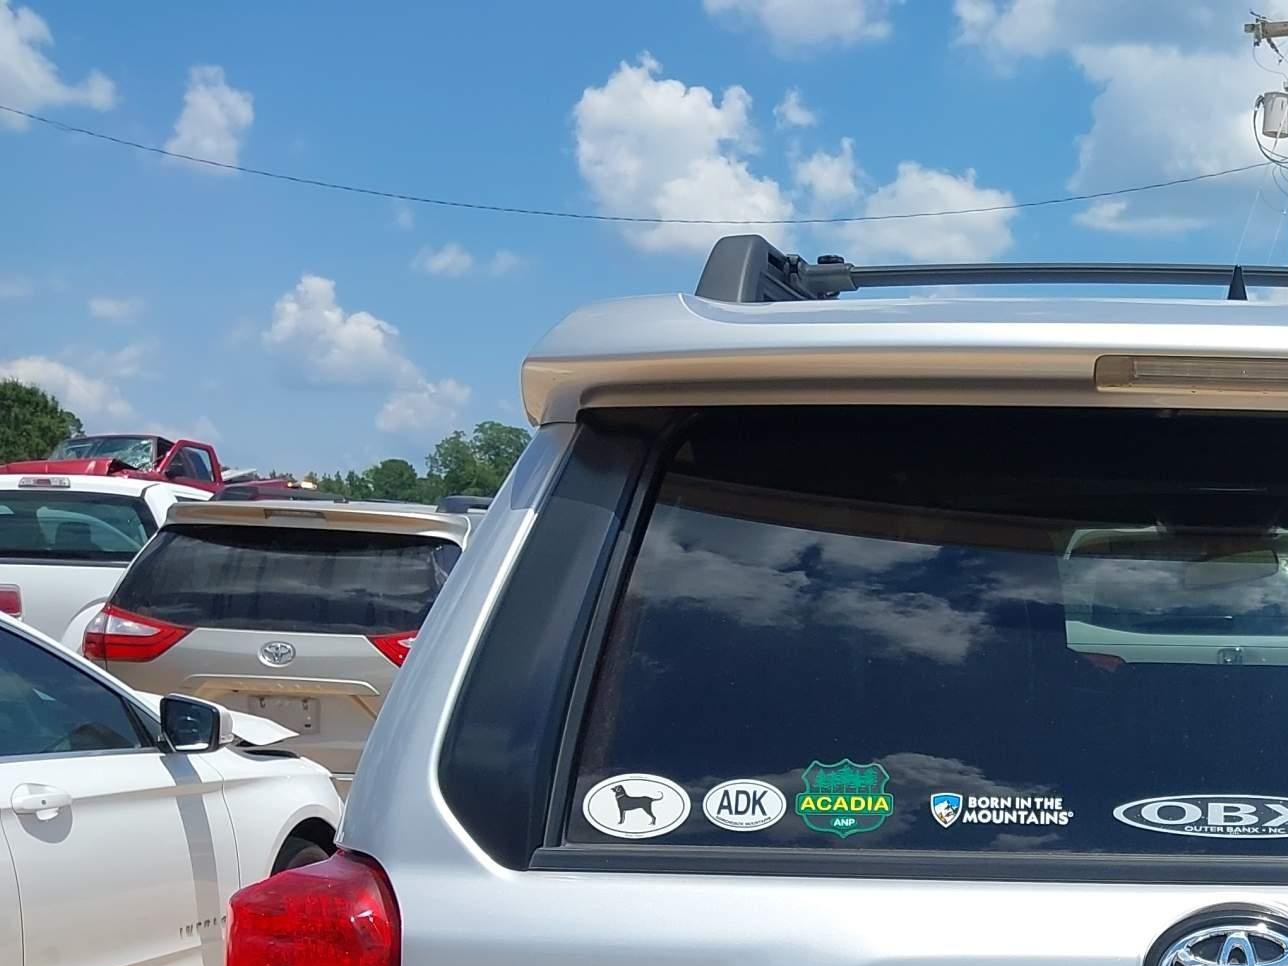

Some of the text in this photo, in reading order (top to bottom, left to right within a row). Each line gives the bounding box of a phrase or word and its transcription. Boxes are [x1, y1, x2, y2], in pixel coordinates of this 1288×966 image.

[716, 789, 768, 817] ADK
[801, 795, 889, 812] ACADIA
[968, 796, 1063, 810] BORN IN THE
[834, 818, 856, 827] ANP
